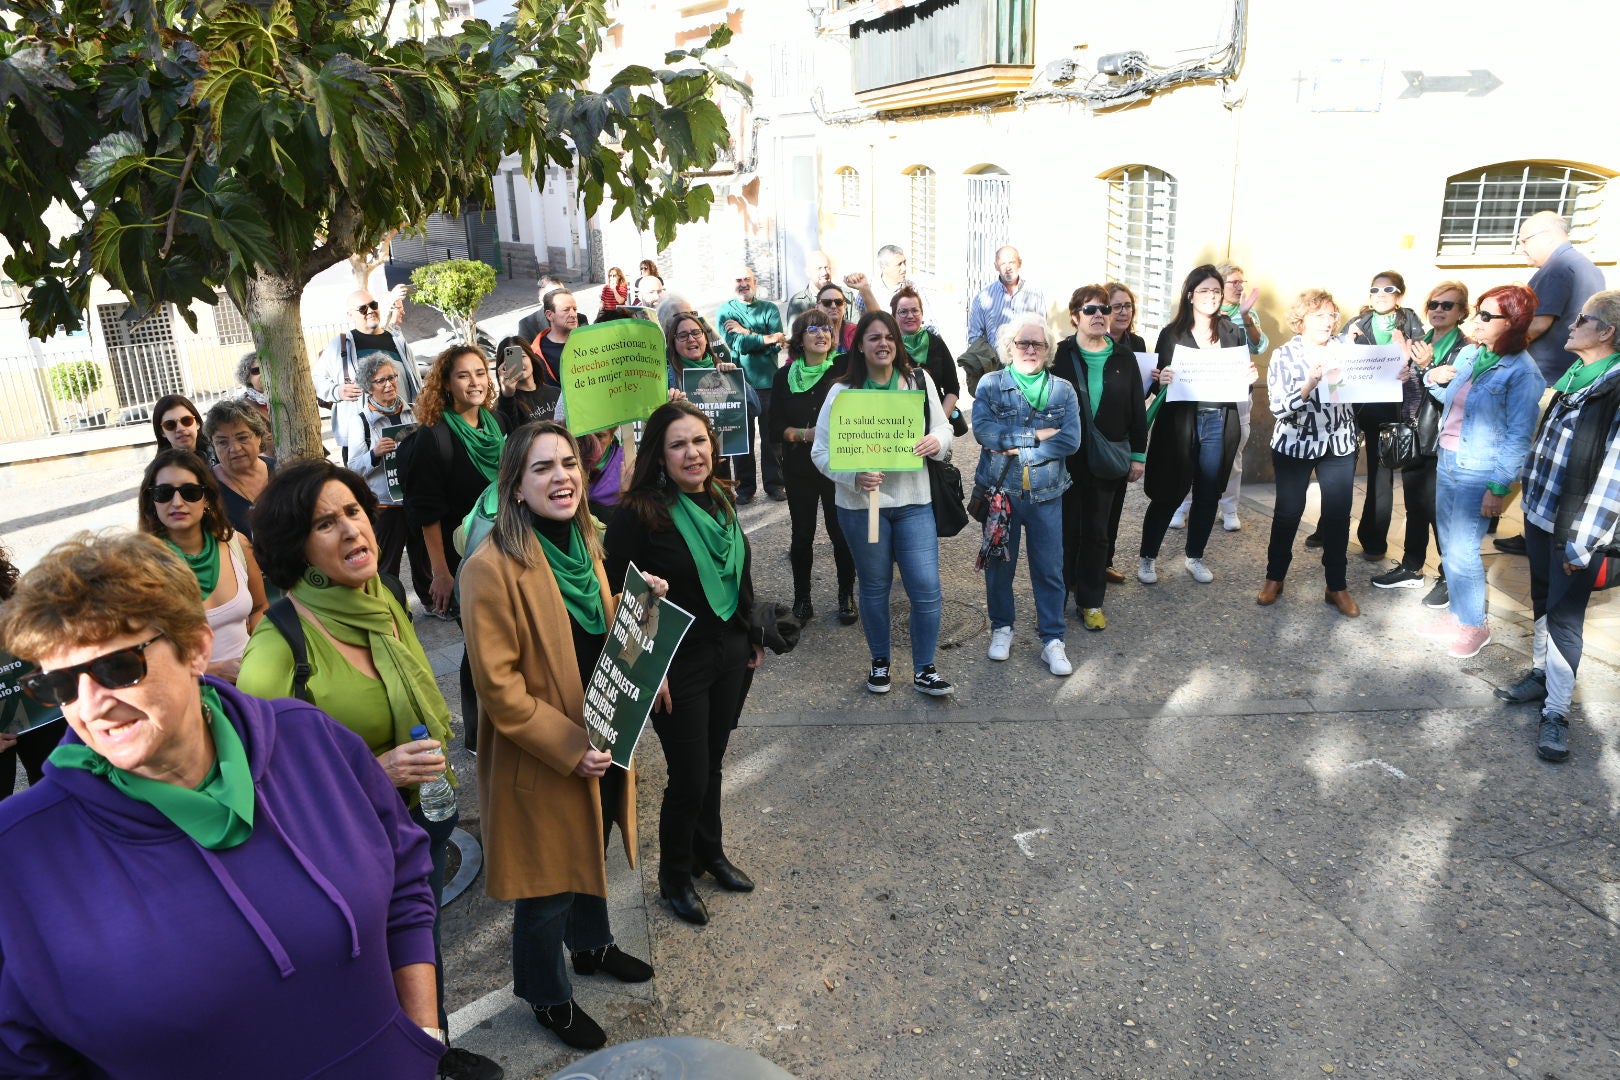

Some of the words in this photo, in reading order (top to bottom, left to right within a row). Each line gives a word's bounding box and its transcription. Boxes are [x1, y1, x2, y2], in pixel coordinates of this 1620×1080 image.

[573, 347, 588, 359] No
[589, 346, 599, 356] se
[601, 338, 647, 353] cuestionan
[570, 359, 610, 375] derechos
[574, 378, 586, 389] de
[587, 375, 596, 386] la
[598, 370, 622, 383] mujer
[608, 384, 623, 398] por
[839, 415, 851, 425] La
[853, 415, 875, 425] salud
[877, 415, 905, 425] sexual
[907, 418, 914, 428] y
[838, 430, 891, 442] reproductiva
[893, 429, 904, 439] de
[907, 429, 915, 439] la
[836, 444, 865, 456] mujer,
[866, 444, 881, 454] NO
[624, 589, 636, 610] NO
[633, 601, 644, 621] LES
[613, 620, 629, 651] VIDA,
[618, 605, 643, 644] IMPORTA
[641, 635, 655, 654] LA
[593, 669, 609, 692] QUE
[606, 682, 619, 703] LAS
[600, 653, 612, 674] LES
[609, 664, 640, 702] MOLESTA
[587, 685, 616, 722] MUJERES
[584, 702, 619, 745] DECIDAMOS
